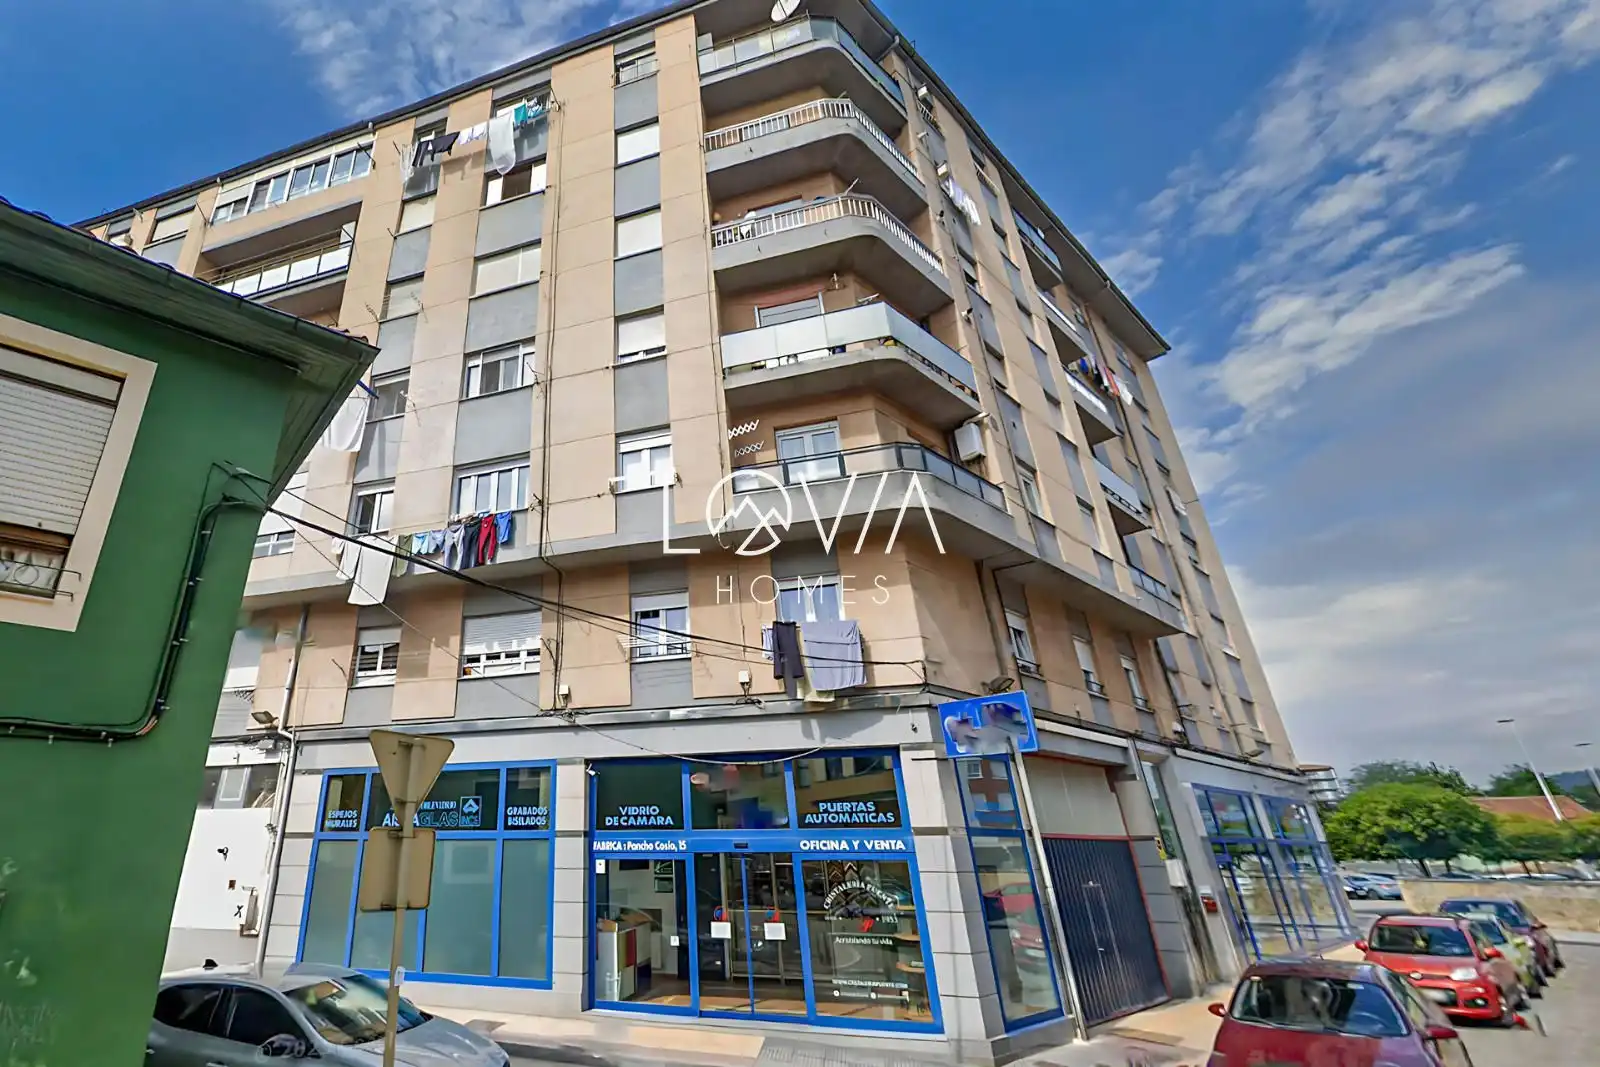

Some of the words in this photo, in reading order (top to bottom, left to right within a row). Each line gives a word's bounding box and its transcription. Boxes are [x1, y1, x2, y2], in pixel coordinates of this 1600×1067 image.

[507, 806, 549, 816] GRABADOS
[619, 805, 660, 816] VIDRIO
[818, 801, 876, 812] PUERTAS
[328, 809, 359, 820] ESPEJOS
[805, 813, 895, 824] AUTOMATICAS
[324, 819, 359, 829] MURALES
[507, 816, 547, 826] BISELADOS
[605, 816, 619, 826] DE
[620, 815, 674, 826] CAMARA
[627, 840, 653, 851] Pancho
[678, 840, 687, 851] 15
[800, 840, 850, 851] OFICINA
[851, 840, 860, 851] Y
[863, 839, 906, 851] VENTA
